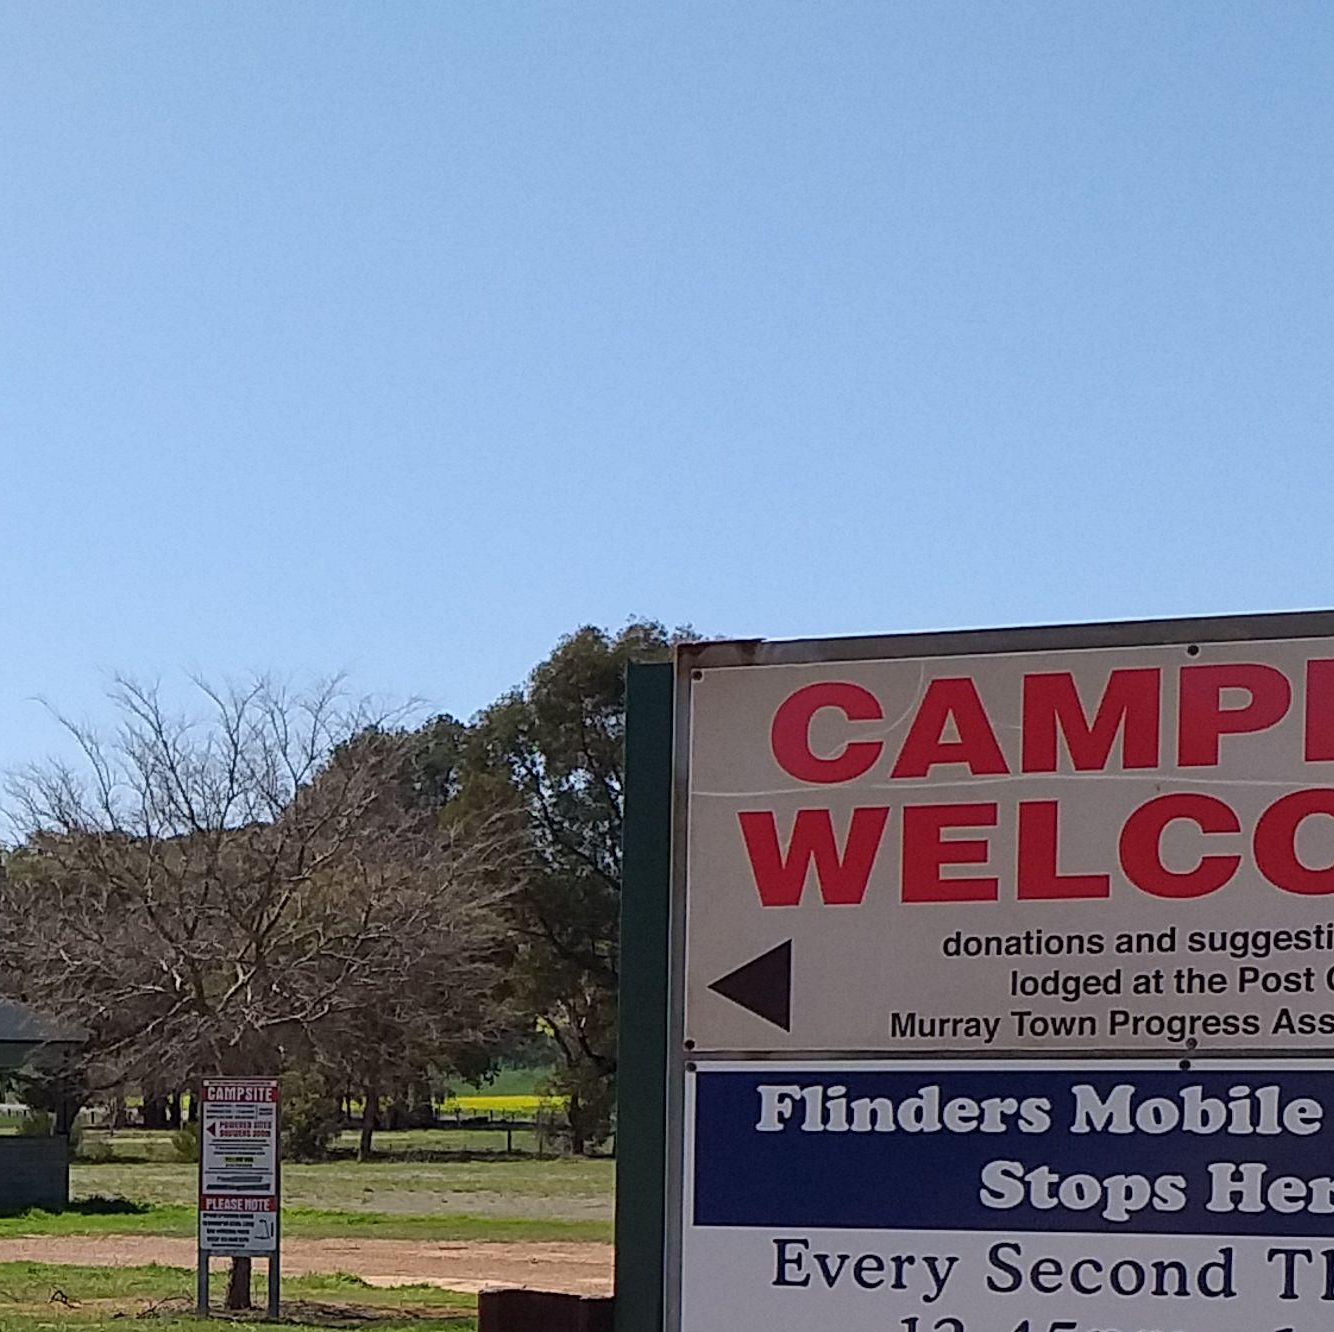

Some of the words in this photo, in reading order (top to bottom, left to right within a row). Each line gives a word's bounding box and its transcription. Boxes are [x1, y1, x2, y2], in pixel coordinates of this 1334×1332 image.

[943, 930, 1104, 956] donations
[1116, 927, 1175, 953] and
[1012, 969, 1121, 1002] lodged
[1133, 970, 1163, 994] at
[1174, 968, 1227, 993] the
[1239, 967, 1315, 992] Post
[892, 1013, 1001, 1043] Murray
[1011, 1011, 1095, 1036] Town
[1110, 1011, 1259, 1042] Progress
[207, 1086, 273, 1101] CAMPSITE
[756, 1085, 1051, 1132] Flinders
[1070, 1085, 1322, 1134] Mobile
[205, 1198, 243, 1211] PLEASE
[980, 1161, 1186, 1221] Stops
[772, 1239, 959, 1302] Every
[987, 1243, 1236, 1298] Second
